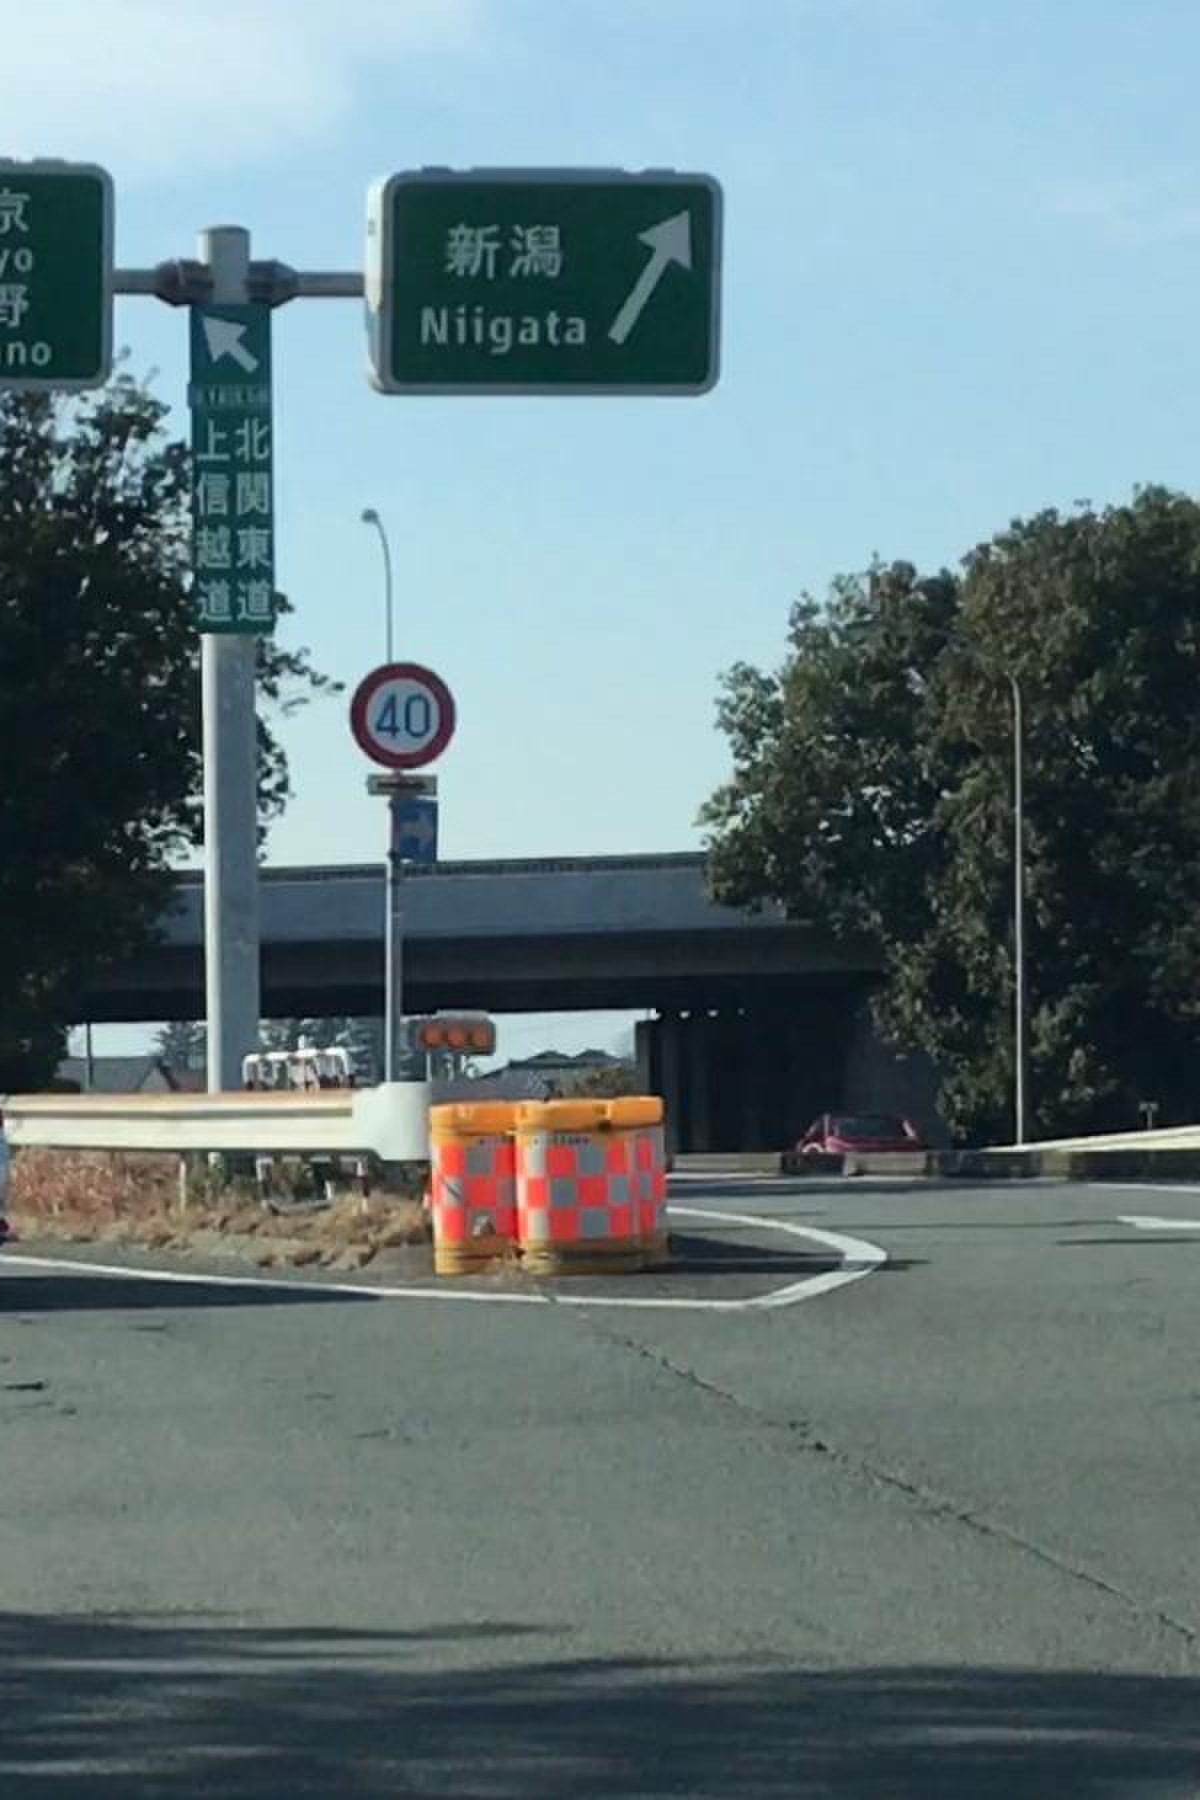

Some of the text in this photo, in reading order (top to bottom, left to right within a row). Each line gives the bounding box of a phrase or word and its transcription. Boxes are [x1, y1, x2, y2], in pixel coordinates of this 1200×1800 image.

[445, 223, 562, 279] 新潟
[420, 307, 587, 355] Niigata
[195, 418, 233, 622] 上信越道
[235, 417, 273, 622] 北関東道
[375, 693, 431, 738] 40
